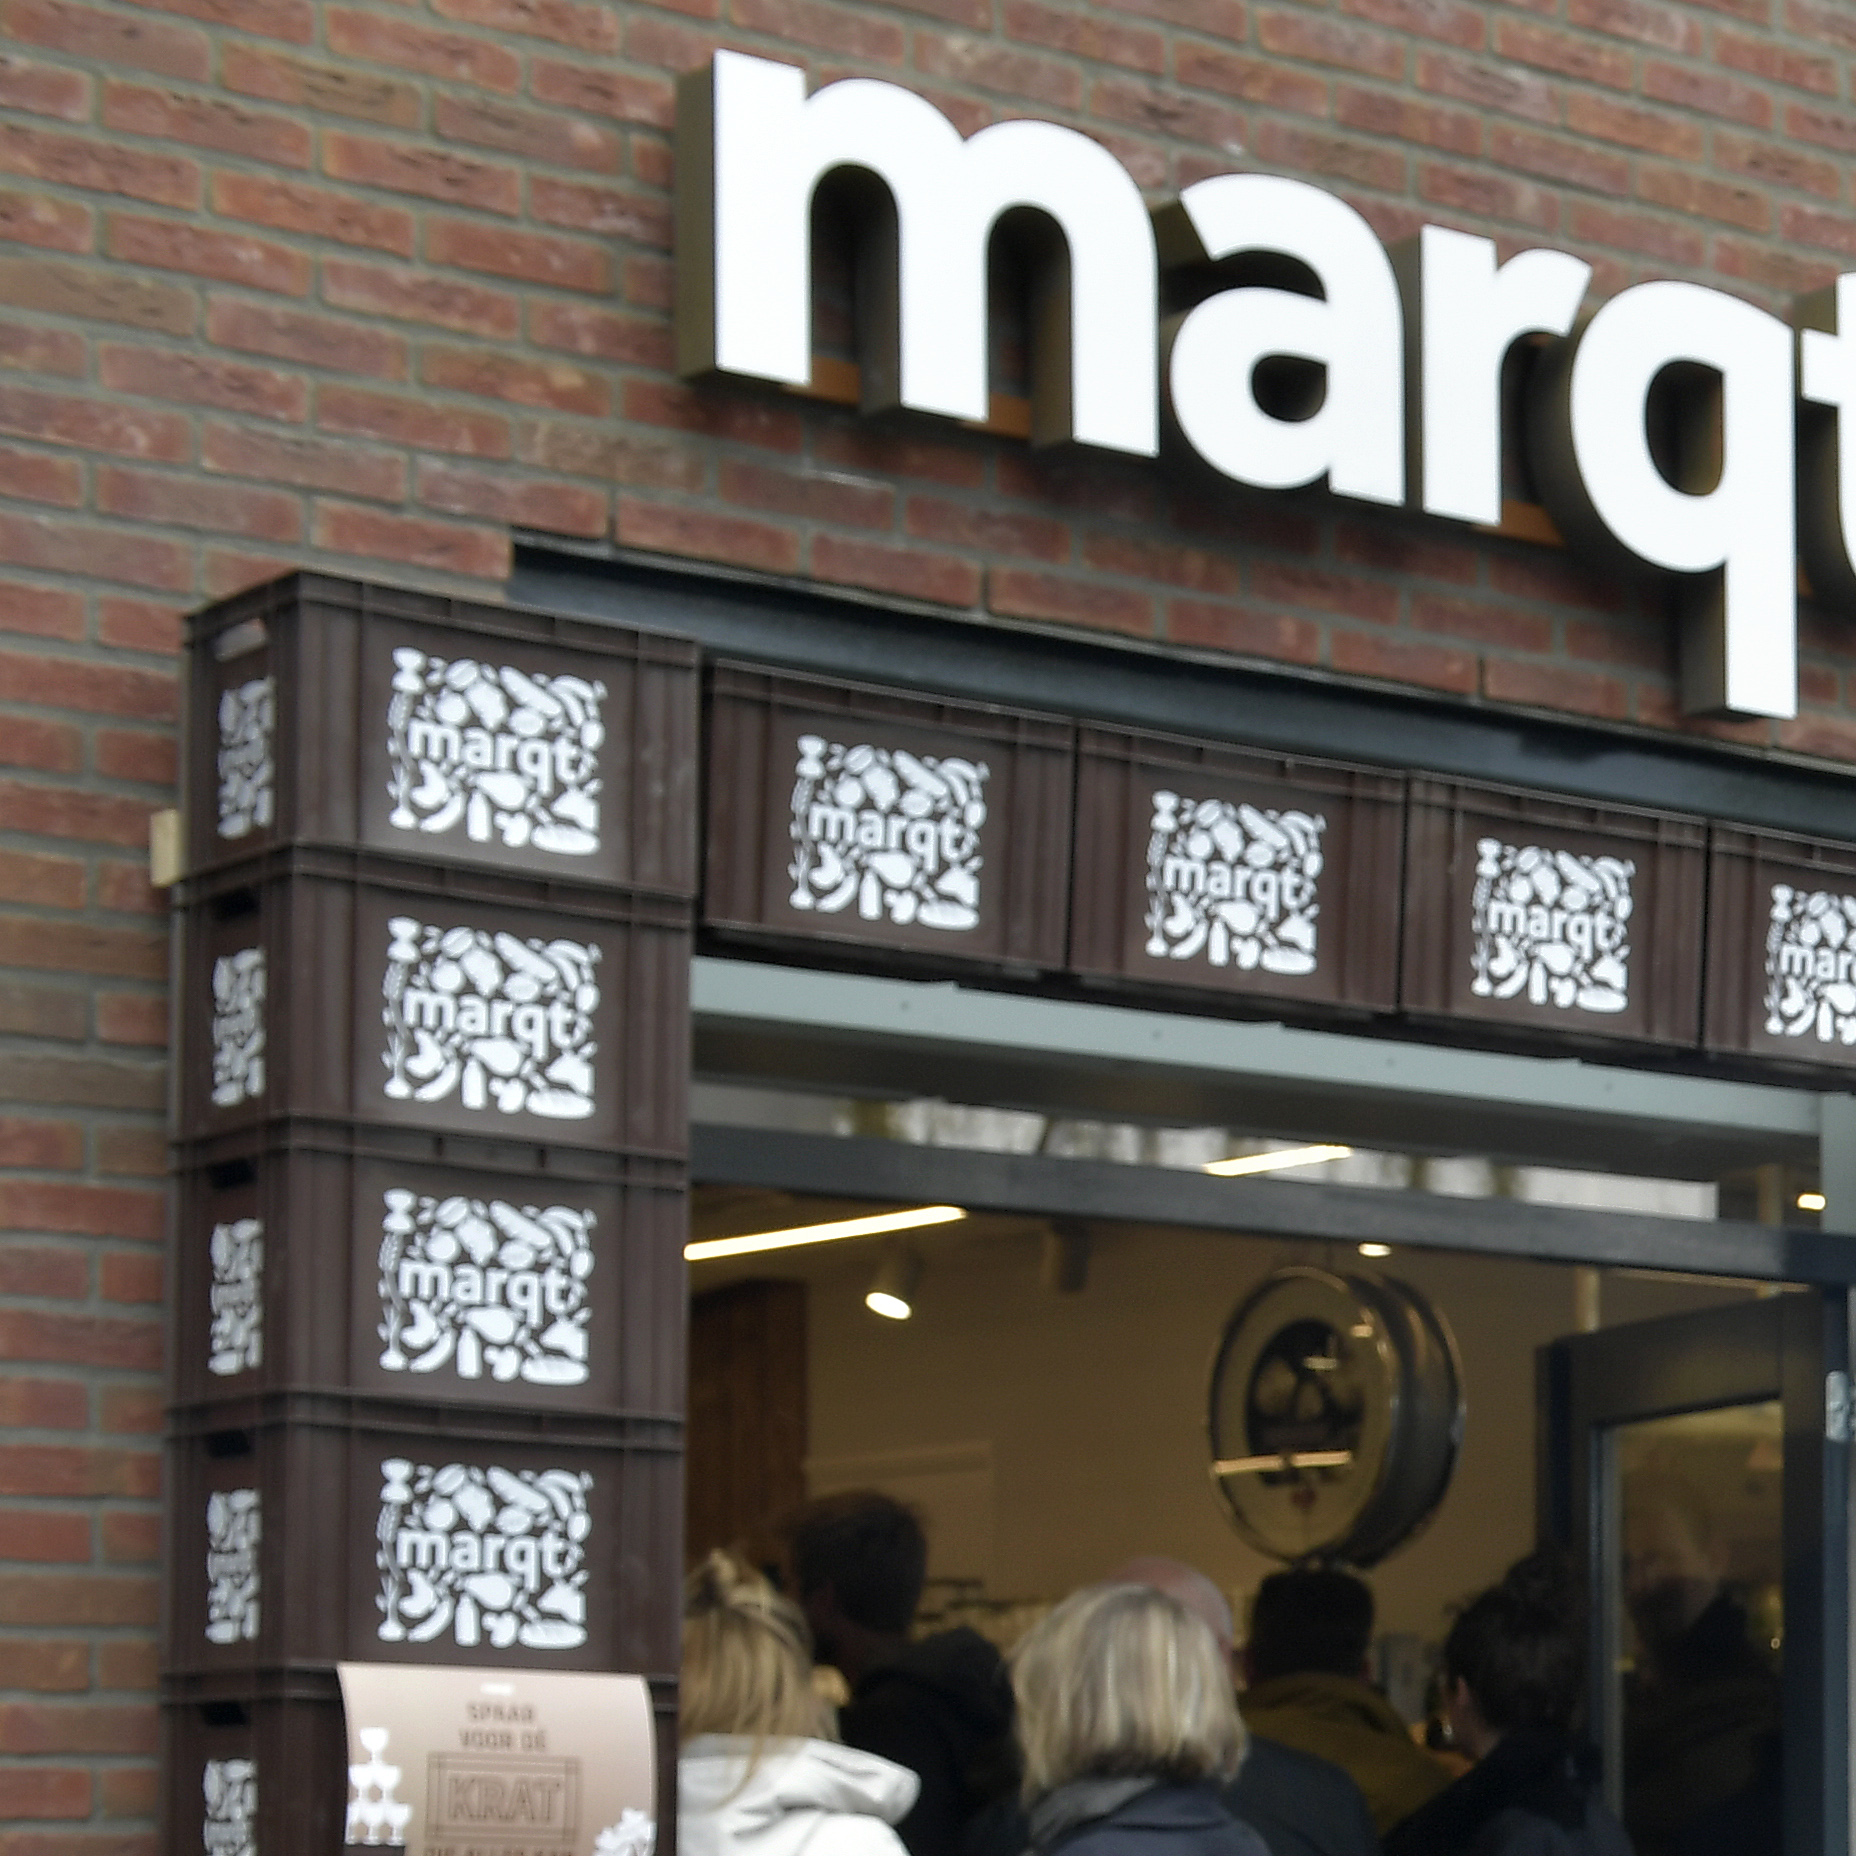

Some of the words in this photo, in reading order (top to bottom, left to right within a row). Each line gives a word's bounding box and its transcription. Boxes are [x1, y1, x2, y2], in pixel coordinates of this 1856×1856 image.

[409, 717, 580, 796] marqt
[808, 801, 961, 869] marqt
[1164, 854, 1304, 923] marqt
[1488, 900, 1617, 958] marqt
[405, 988, 576, 1062] marqt
[400, 1262, 571, 1328] marqt
[397, 1530, 567, 1591] marqt
